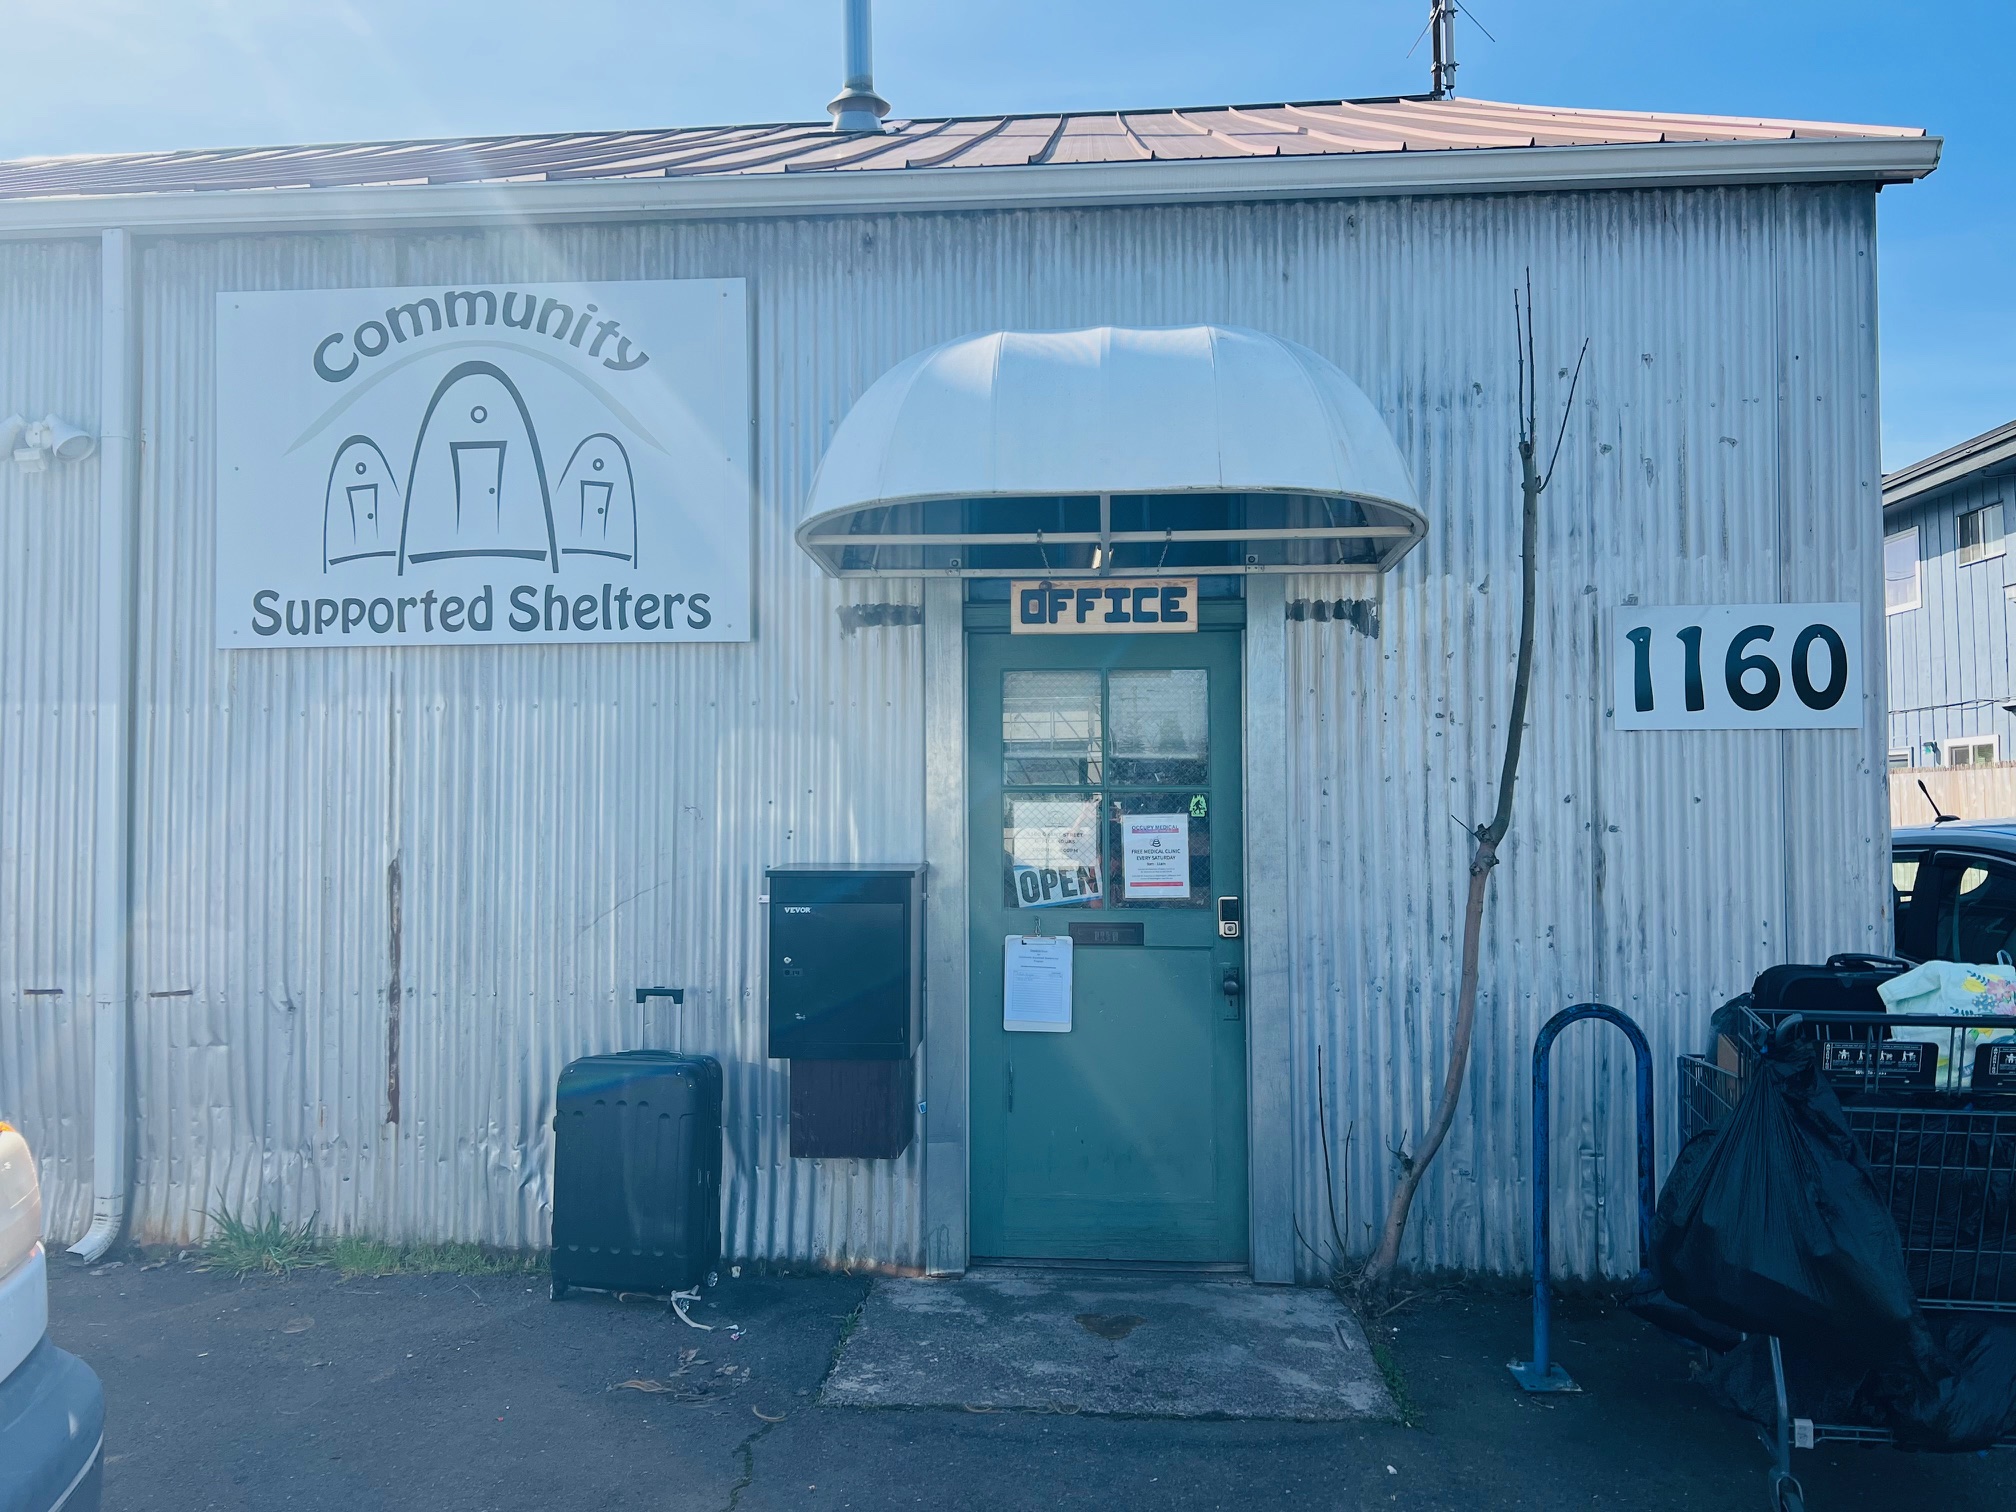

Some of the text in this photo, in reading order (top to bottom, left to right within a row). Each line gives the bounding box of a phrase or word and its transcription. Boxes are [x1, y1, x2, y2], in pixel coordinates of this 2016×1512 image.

[313, 290, 650, 383] Community
[251, 583, 712, 636] Supported Shelters
[1021, 586, 1188, 624] OFFICE
[1626, 623, 1848, 712] 1160
[1019, 866, 1099, 903] OPEN
[784, 906, 811, 914] VEVOR
